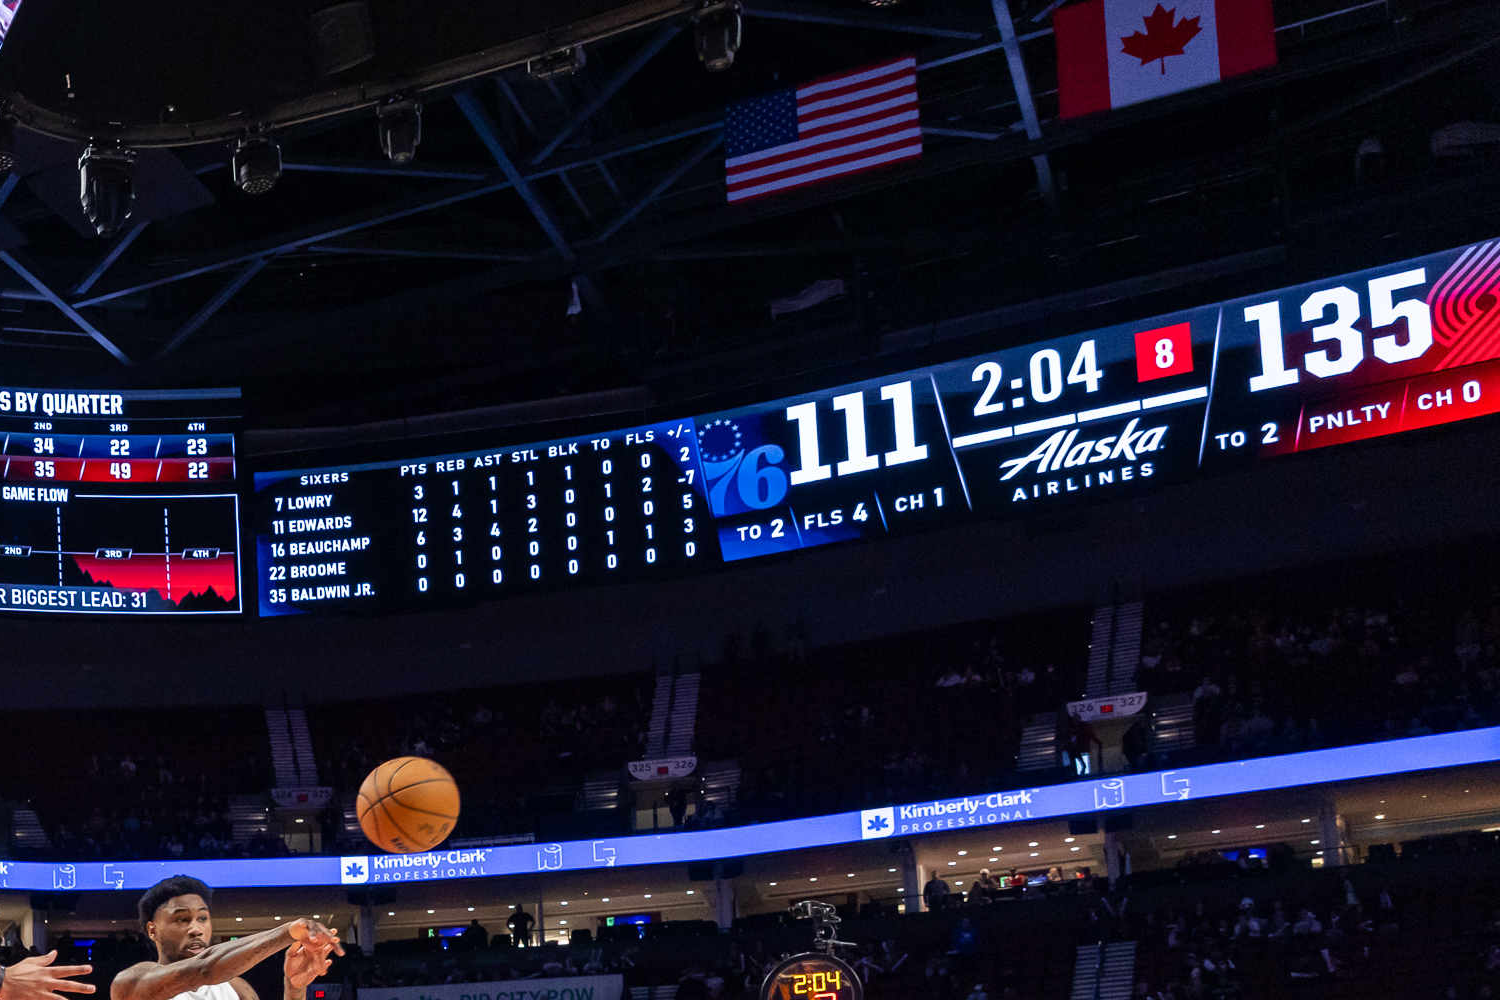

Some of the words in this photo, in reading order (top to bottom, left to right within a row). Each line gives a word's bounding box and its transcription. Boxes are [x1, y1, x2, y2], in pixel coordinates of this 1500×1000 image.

[1156, 339, 1173, 368] 8
[1244, 265, 1433, 393] 135
[15, 392, 38, 412] BY
[42, 393, 122, 416] QUARTER
[971, 339, 1103, 417] 2:04
[35, 422, 52, 430] 2ND
[787, 381, 927, 485] 111
[1215, 432, 1245, 449] TO
[1261, 423, 1278, 443] 2
[1310, 402, 1390, 432] PNLTY
[1418, 389, 1452, 409] CH
[1463, 381, 1480, 402] 0
[34, 438, 54, 453] 34
[111, 440, 129, 455] 22
[187, 439, 207, 454] 23
[35, 461, 54, 477] 35
[110, 463, 131, 478] 49
[188, 462, 208, 478] 22
[301, 473, 348, 485] SIXERS
[401, 464, 426, 476] PTS
[436, 459, 464, 472] REB
[474, 454, 501, 467] AST
[512, 450, 538, 462] STL
[549, 443, 578, 457] BLK
[591, 439, 609, 450] TO
[626, 431, 654, 445] FLS
[667, 424, 690, 438] +/-
[999, 417, 1166, 481] Alaska
[3, 487, 35, 500] GAME
[38, 488, 68, 502] FLOW
[273, 520, 284, 534] 11
[289, 516, 351, 532] EDWARDS
[413, 508, 427, 522] 12
[452, 504, 461, 517] 4
[491, 500, 496, 513] 1
[527, 495, 536, 508] 3
[566, 490, 574, 503] 0
[605, 484, 611, 497] 1
[642, 477, 651, 492] 2
[678, 470, 694, 484] -7
[275, 498, 282, 511] 7
[288, 495, 332, 509] LOWRY
[415, 486, 423, 499] 3
[452, 481, 458, 495] 1
[490, 477, 495, 490] 1
[527, 472, 533, 485] 1
[565, 466, 571, 479] 1
[603, 460, 611, 474] 0
[641, 454, 650, 468] 0
[680, 447, 689, 461] 2
[1012, 462, 1154, 502] AIRLINES
[271, 543, 285, 557] 16
[290, 537, 369, 555] BEAUCHAMP
[417, 532, 425, 545] 6
[454, 528, 462, 541] 3
[491, 523, 500, 536] 4
[528, 518, 537, 532] 2
[567, 513, 575, 526] 0
[605, 507, 614, 521] 0
[644, 501, 653, 515] 0
[683, 494, 692, 508] 5
[737, 525, 761, 541] TO
[771, 519, 784, 538] 2
[804, 510, 842, 529] FLS
[853, 503, 868, 521] 4
[896, 494, 923, 511] CH
[934, 488, 942, 506] 1
[269, 566, 285, 580] 22
[291, 562, 345, 578] BROOME
[418, 555, 426, 568] 0
[456, 551, 461, 564] 1
[492, 546, 501, 560] 0
[530, 542, 538, 555] 0
[568, 536, 577, 550] 0
[607, 531, 613, 544] 1
[646, 525, 652, 539] 1
[684, 518, 693, 532] 3
[270, 589, 286, 603] 35
[292, 585, 349, 601] BALDWIN
[354, 583, 374, 596] JR.
[419, 578, 427, 591] 0
[456, 574, 464, 587] 0
[493, 570, 502, 583] 0
[531, 565, 539, 578] 0
[569, 560, 578, 573] 0
[608, 554, 616, 568] 0
[647, 549, 655, 562] 0
[686, 542, 695, 556] 0
[12, 589, 77, 606] BIGGEST
[82, 591, 126, 607] LEAD:
[132, 592, 146, 607] 31
[901, 809, 1034, 833] PROFESSIONAL
[374, 868, 487, 882] PROFESSIONAL
[793, 971, 841, 994] 2:04
